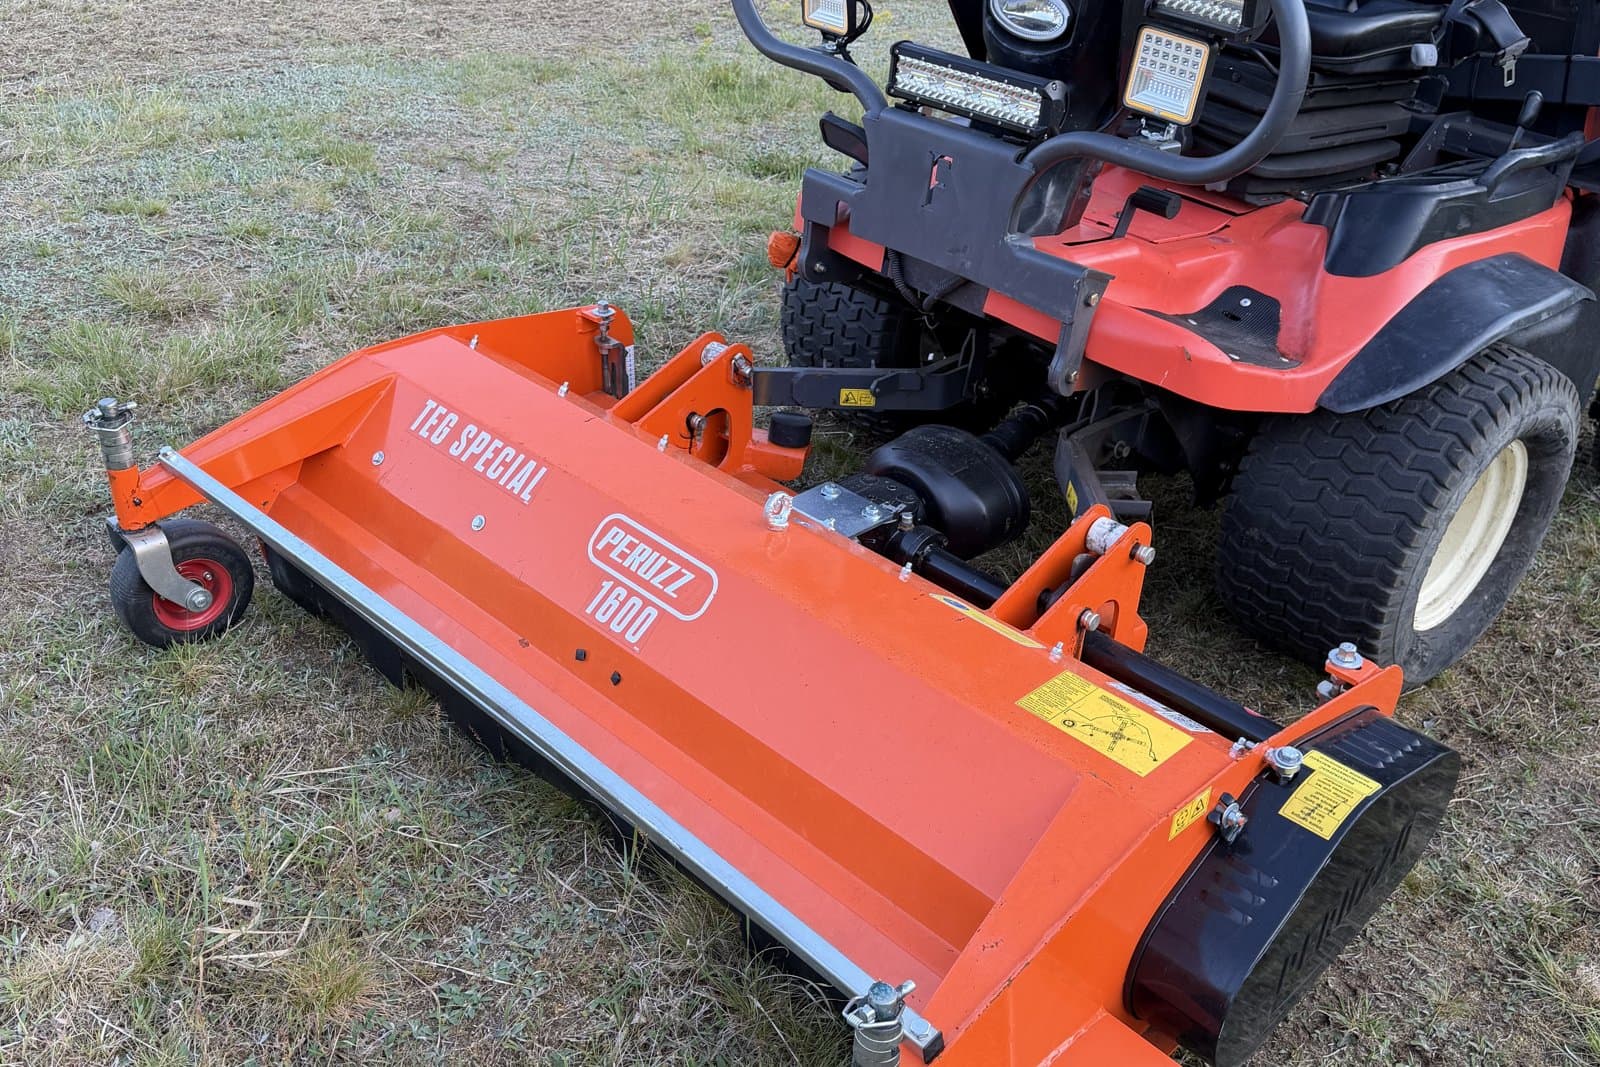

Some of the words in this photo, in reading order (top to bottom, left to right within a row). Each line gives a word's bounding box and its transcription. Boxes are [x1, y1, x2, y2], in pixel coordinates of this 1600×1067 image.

[410, 399, 459, 445] TEG
[449, 423, 547, 502] SPECIAL
[585, 580, 658, 644] 1600
